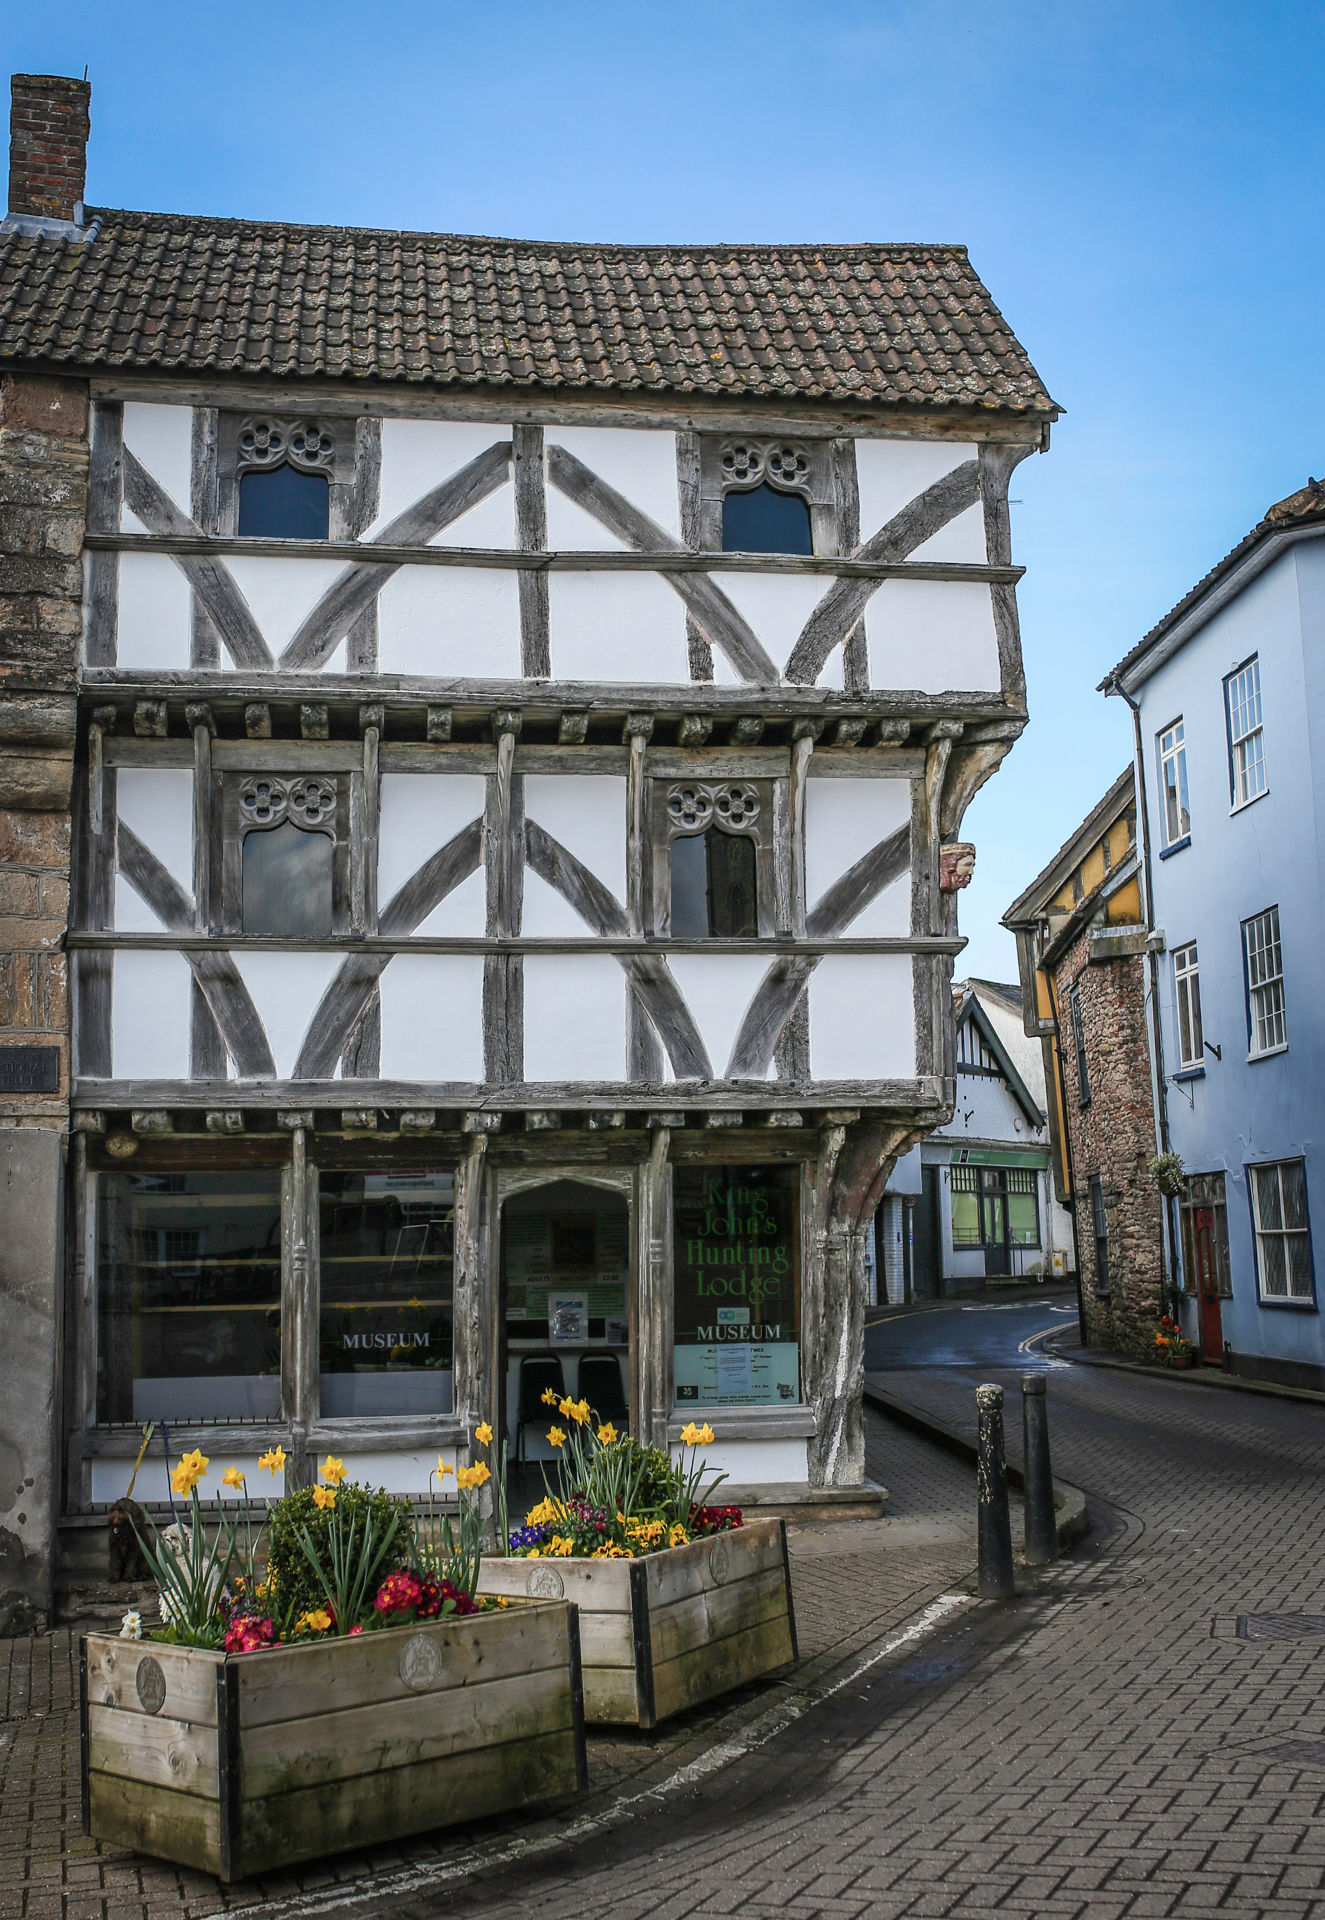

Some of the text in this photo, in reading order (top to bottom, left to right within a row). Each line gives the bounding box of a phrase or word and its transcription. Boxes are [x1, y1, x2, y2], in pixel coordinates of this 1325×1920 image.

[708, 1179, 768, 1214] King
[697, 1210, 777, 1235] John's
[687, 1239, 788, 1274] Hunting
[697, 1267, 781, 1304] Lodge
[342, 1332, 430, 1349] MUSEUM
[697, 1324, 781, 1341] MUSEUM
